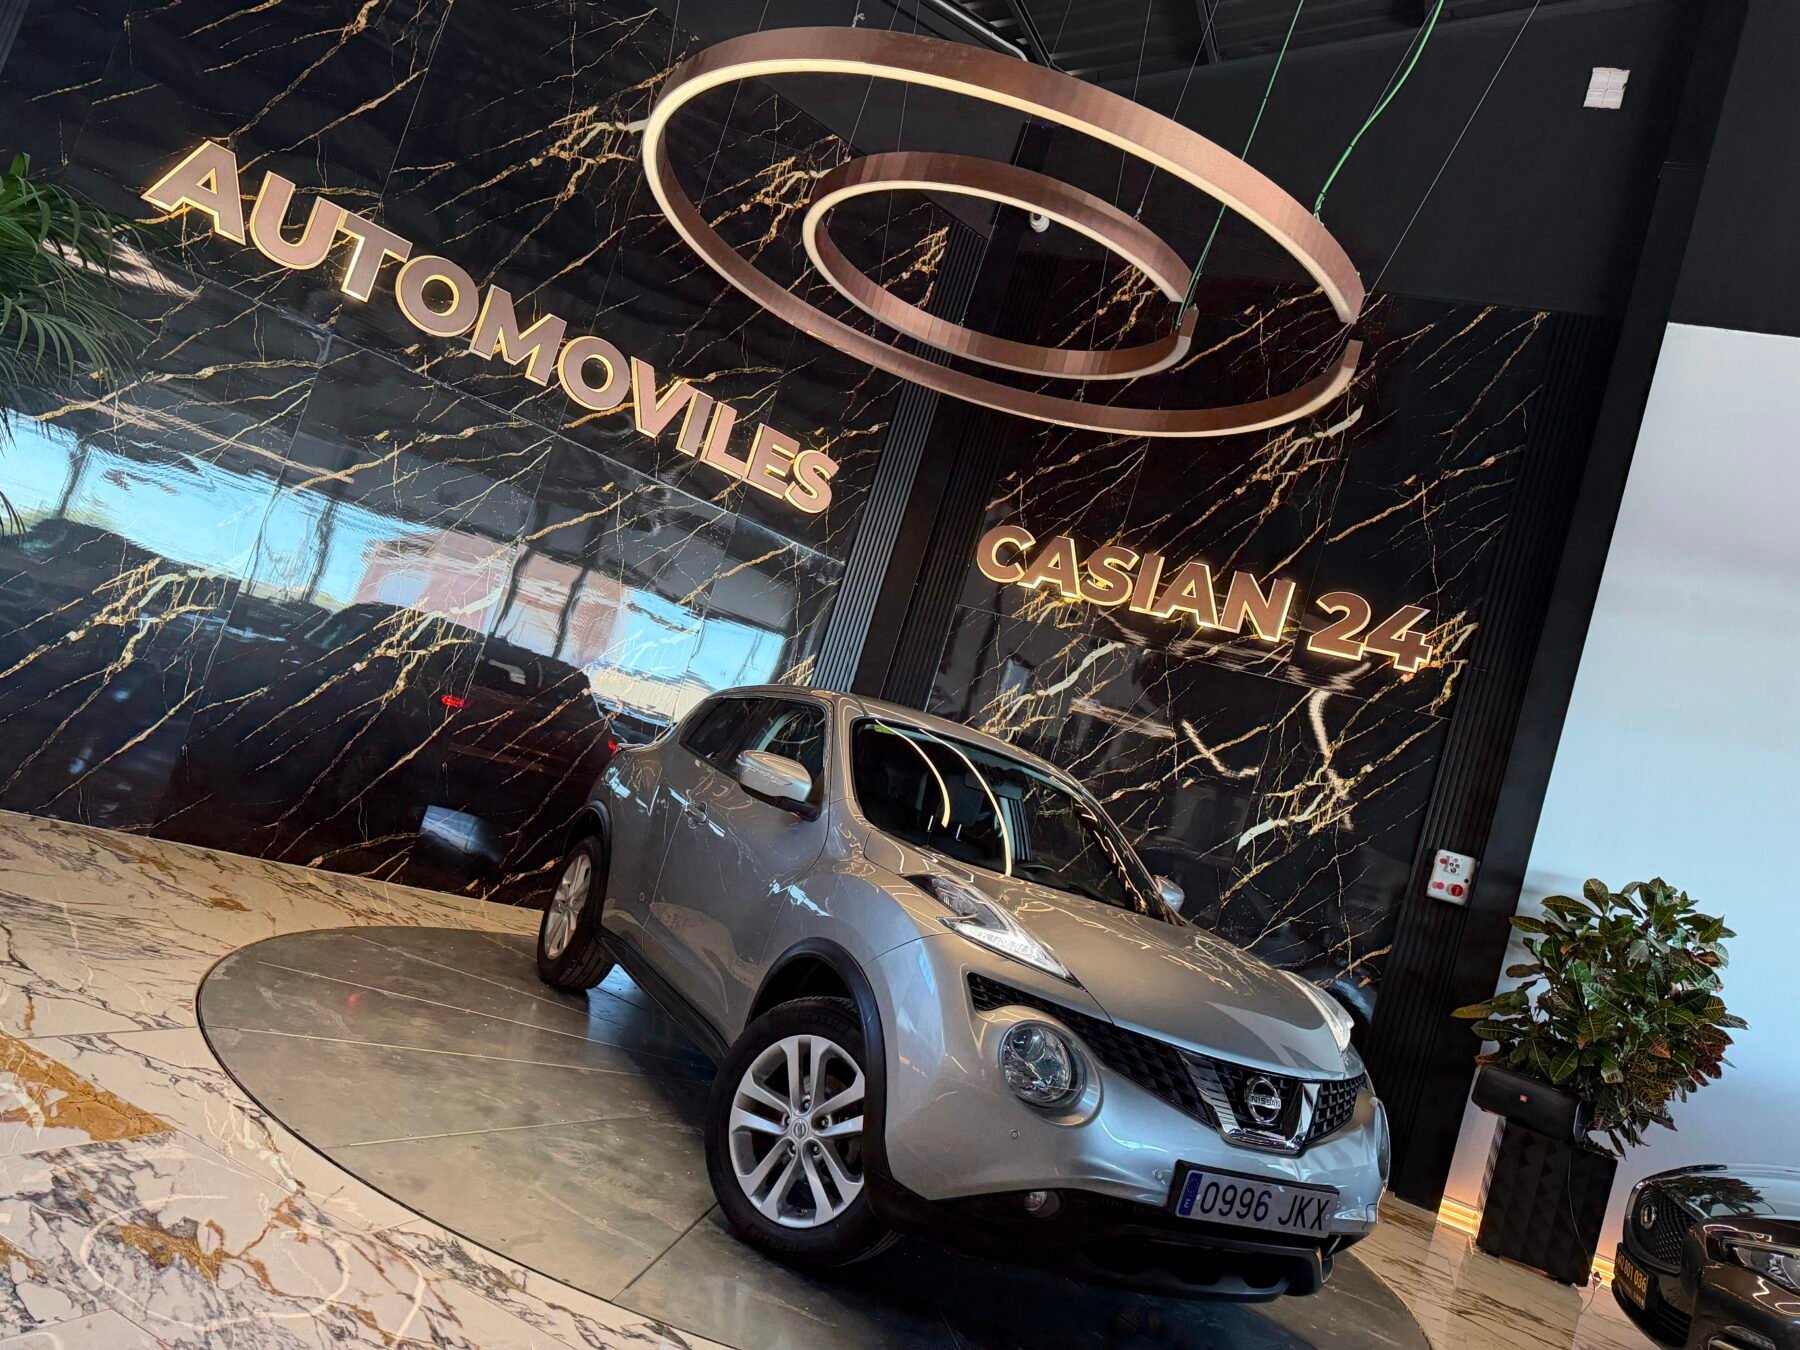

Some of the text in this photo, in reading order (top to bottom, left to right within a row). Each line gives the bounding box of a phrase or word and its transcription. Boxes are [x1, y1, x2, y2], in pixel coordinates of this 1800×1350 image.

[141, 140, 840, 514] AUTOMOVILES
[976, 525, 1433, 673] CASIAN 24
[1250, 1095, 1281, 1108] NISSAN
[1200, 1181, 1330, 1231] 0996 JKX
